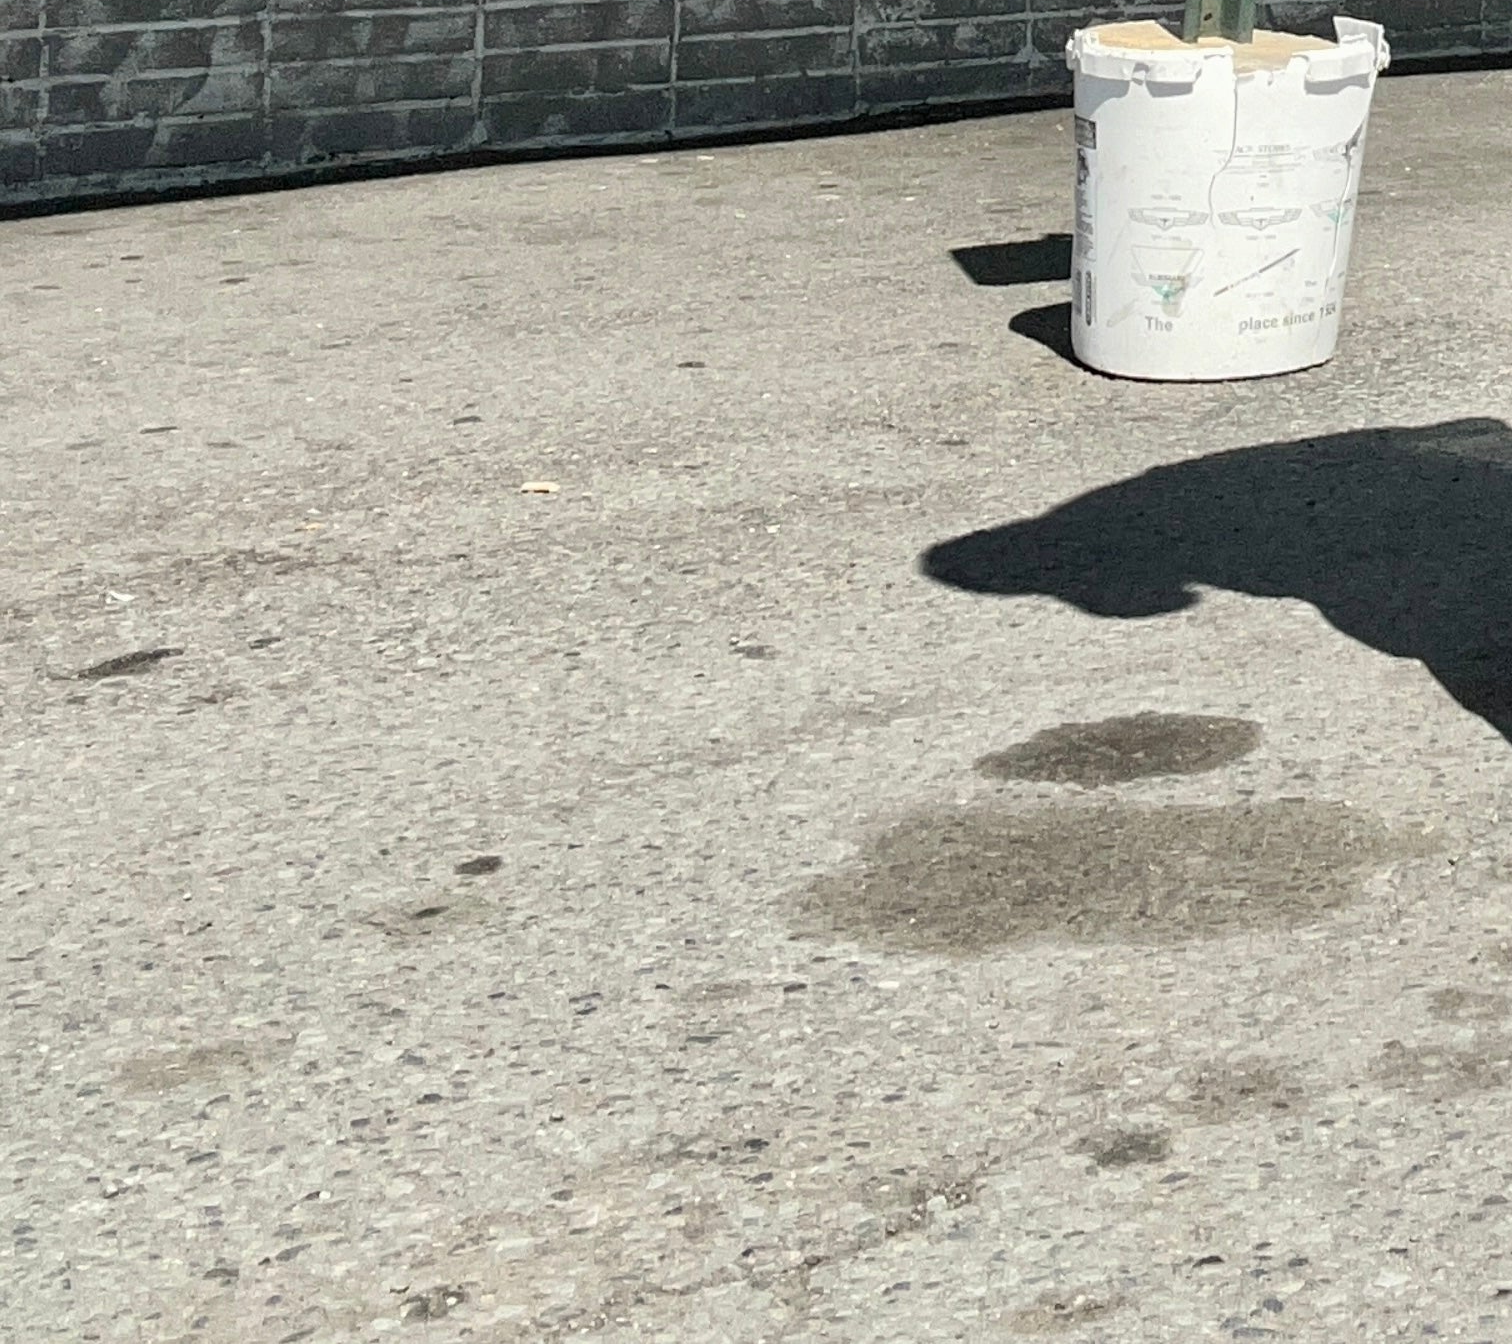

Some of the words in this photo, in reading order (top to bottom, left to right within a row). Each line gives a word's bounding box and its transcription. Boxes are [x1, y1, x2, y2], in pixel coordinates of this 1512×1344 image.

[1145, 315, 1174, 332] The
[1238, 316, 1279, 335] place
[1282, 311, 1315, 327] since
